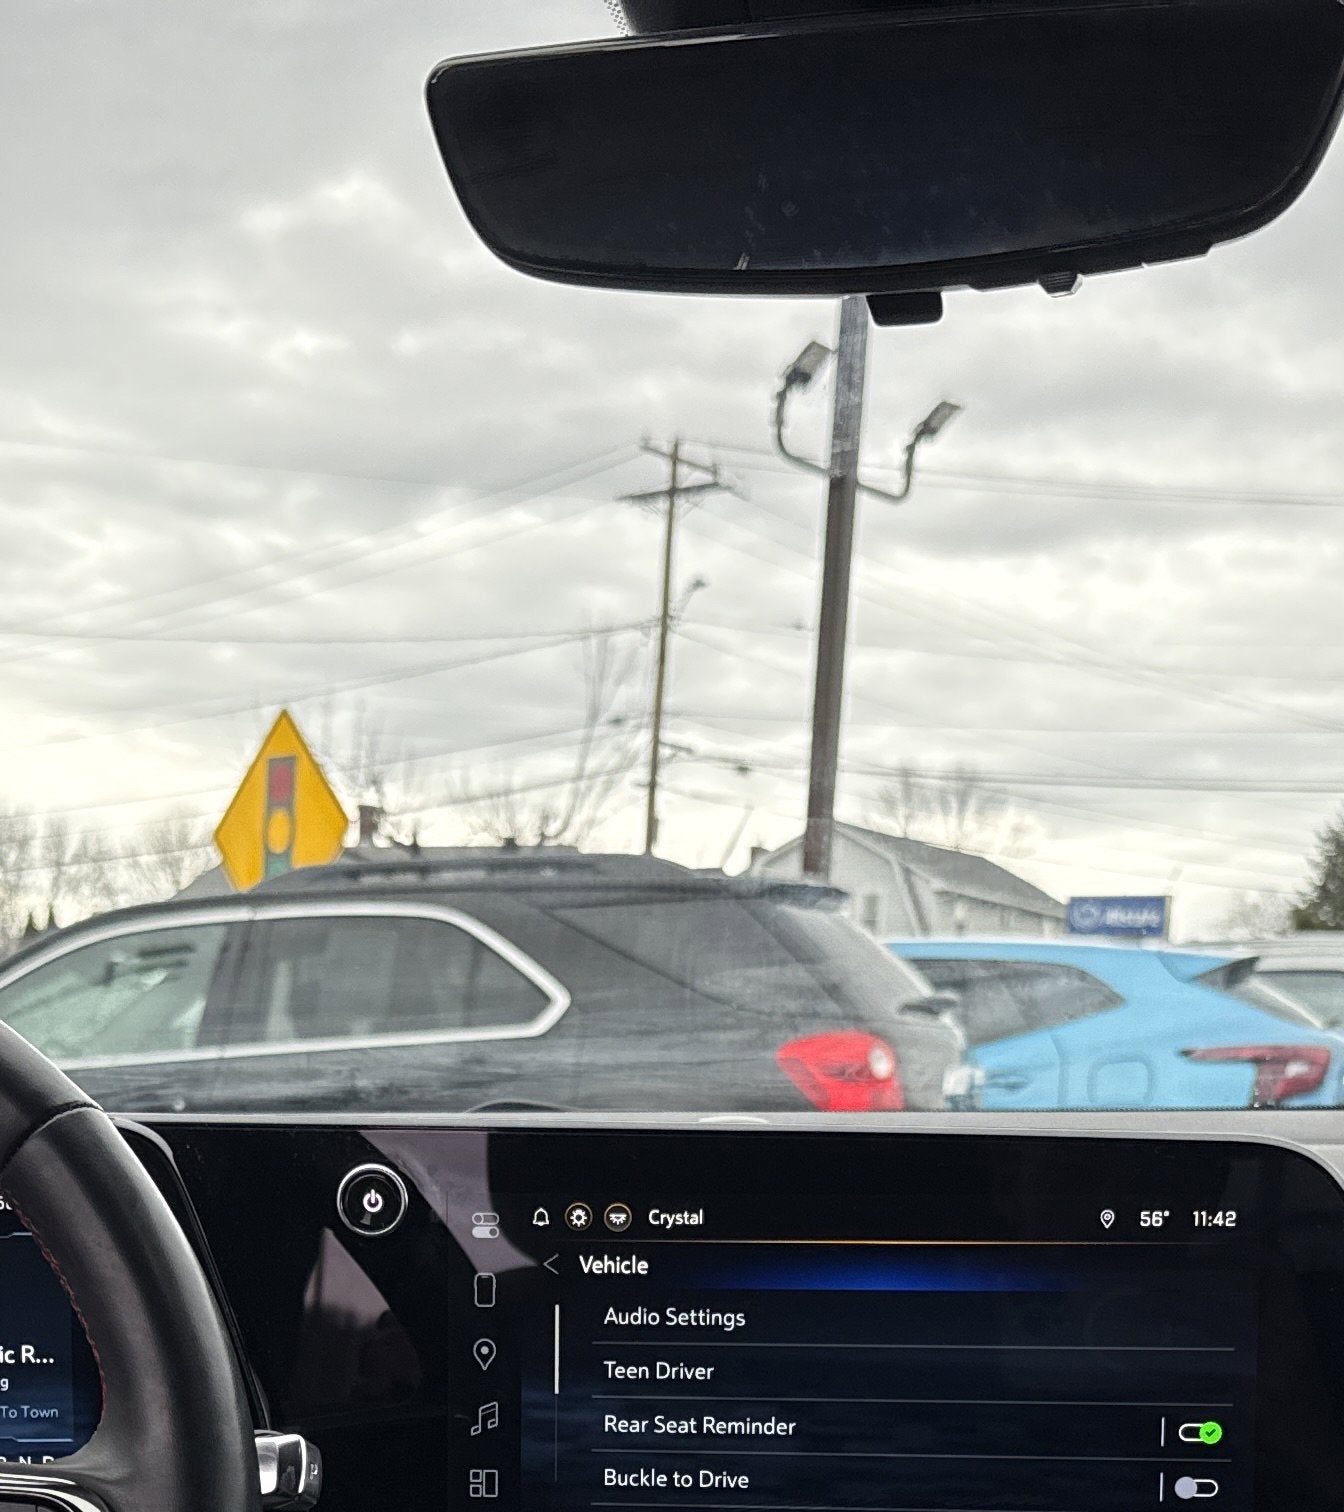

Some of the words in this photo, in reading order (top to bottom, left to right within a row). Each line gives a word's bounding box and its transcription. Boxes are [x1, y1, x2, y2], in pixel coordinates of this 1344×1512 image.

[648, 1208, 703, 1227] Crystal
[1140, 1209, 1170, 1227] 56°
[1193, 1211, 1236, 1227] 11:42
[579, 1255, 649, 1275] Vehicle
[604, 1307, 660, 1327] Audio
[665, 1307, 746, 1331] Settings
[21, 1346, 55, 1365] R...
[604, 1361, 649, 1380] Teen
[656, 1361, 714, 1381] Driver
[0, 1405, 18, 1419] To
[20, 1405, 59, 1419] Town
[604, 1415, 648, 1434] Rear
[653, 1415, 697, 1435] Seat
[703, 1415, 797, 1437] Reminder
[604, 1469, 667, 1488] Buckle
[672, 1471, 693, 1489] to
[699, 1469, 749, 1489] Drive
